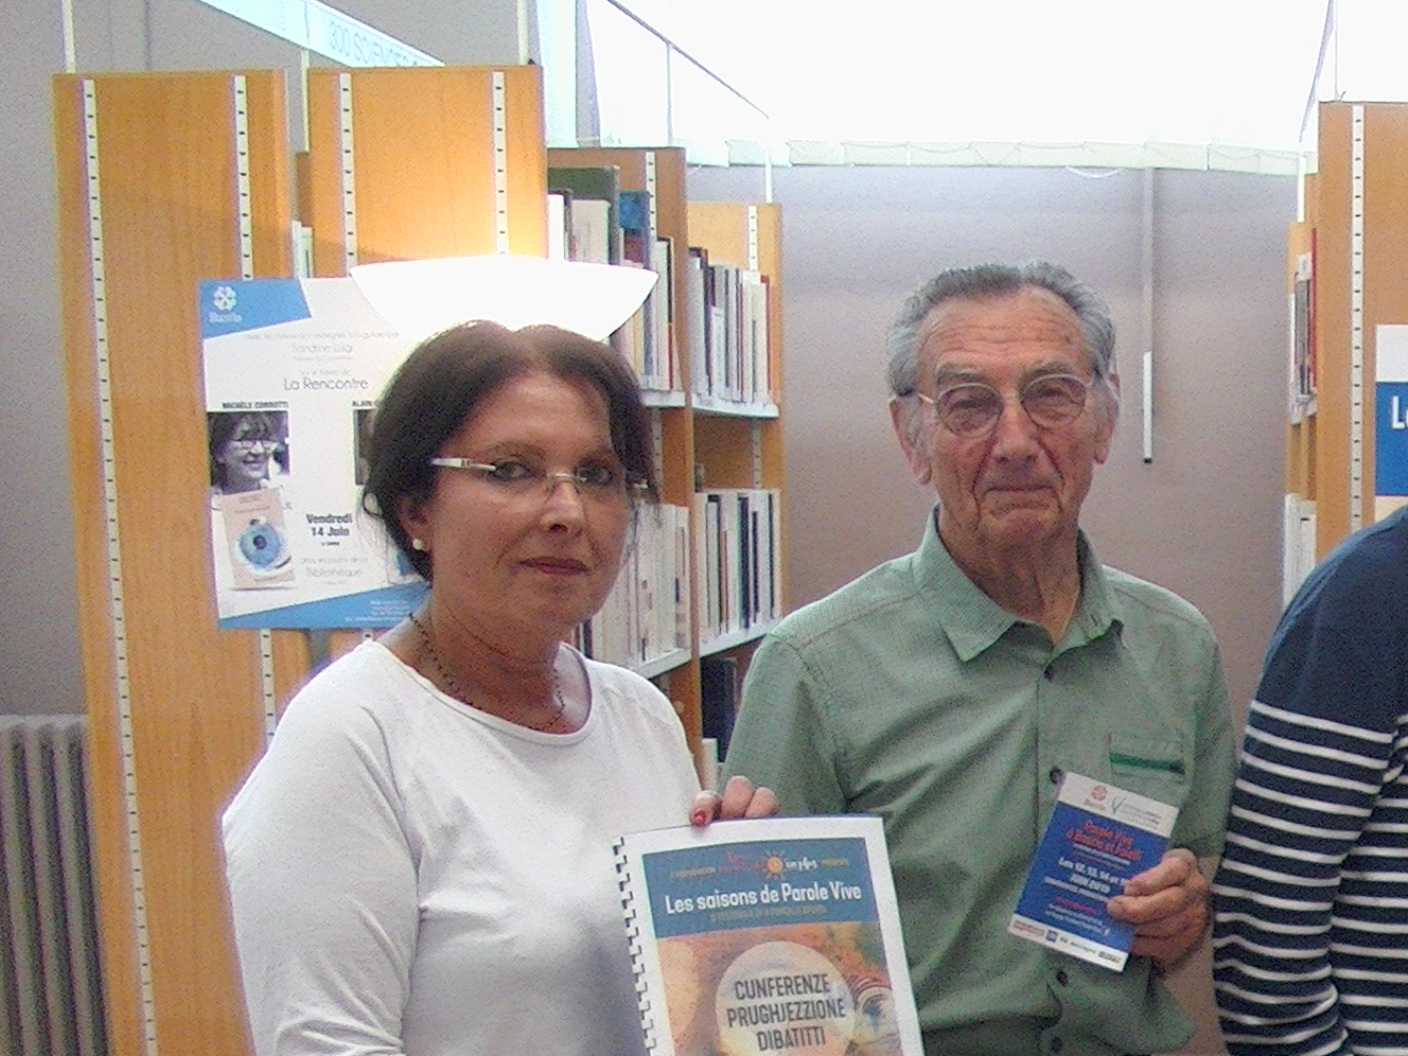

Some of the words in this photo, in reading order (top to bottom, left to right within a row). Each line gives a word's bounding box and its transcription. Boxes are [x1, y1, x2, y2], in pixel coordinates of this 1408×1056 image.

[284, 378, 300, 391] La
[303, 377, 369, 391] Rencontre
[306, 513, 353, 524] Vendredi
[311, 527, 324, 536] 14
[327, 526, 350, 536] Juin
[664, 895, 694, 914] Les
[697, 889, 759, 910] saisons
[760, 884, 779, 904] de
[781, 882, 829, 902] Parole
[829, 880, 862, 900] Vive
[734, 973, 831, 1001] CUNFERENZE
[726, 998, 847, 1028] PRUGHJEZZIONE
[756, 1025, 827, 1052] DIBATITTI
